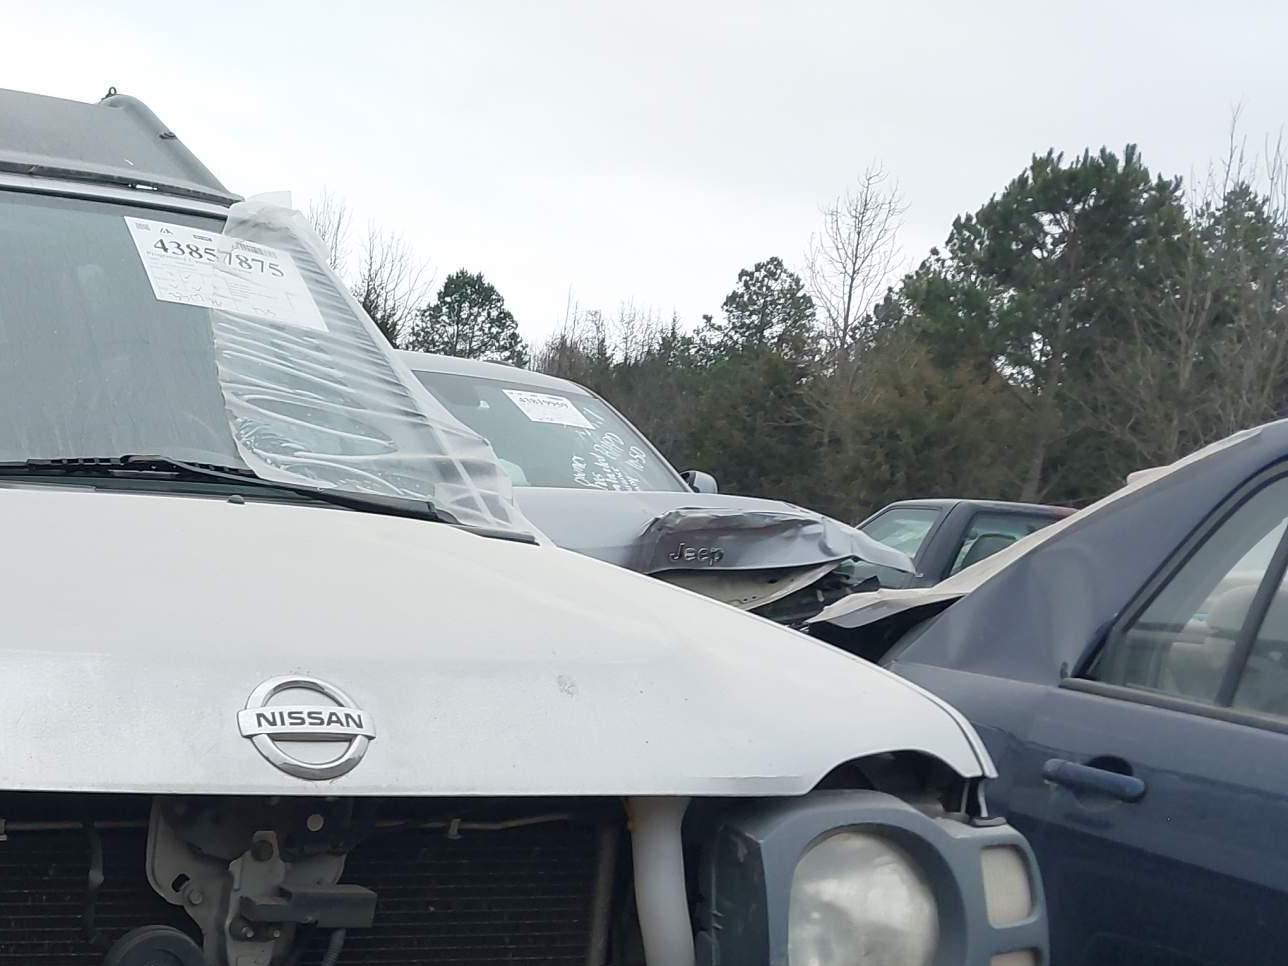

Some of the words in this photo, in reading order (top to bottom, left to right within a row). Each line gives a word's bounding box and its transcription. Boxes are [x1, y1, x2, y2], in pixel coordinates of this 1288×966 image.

[153, 238, 285, 278] 43857875
[668, 542, 725, 567] Jeep
[256, 711, 364, 729] NISSAN
